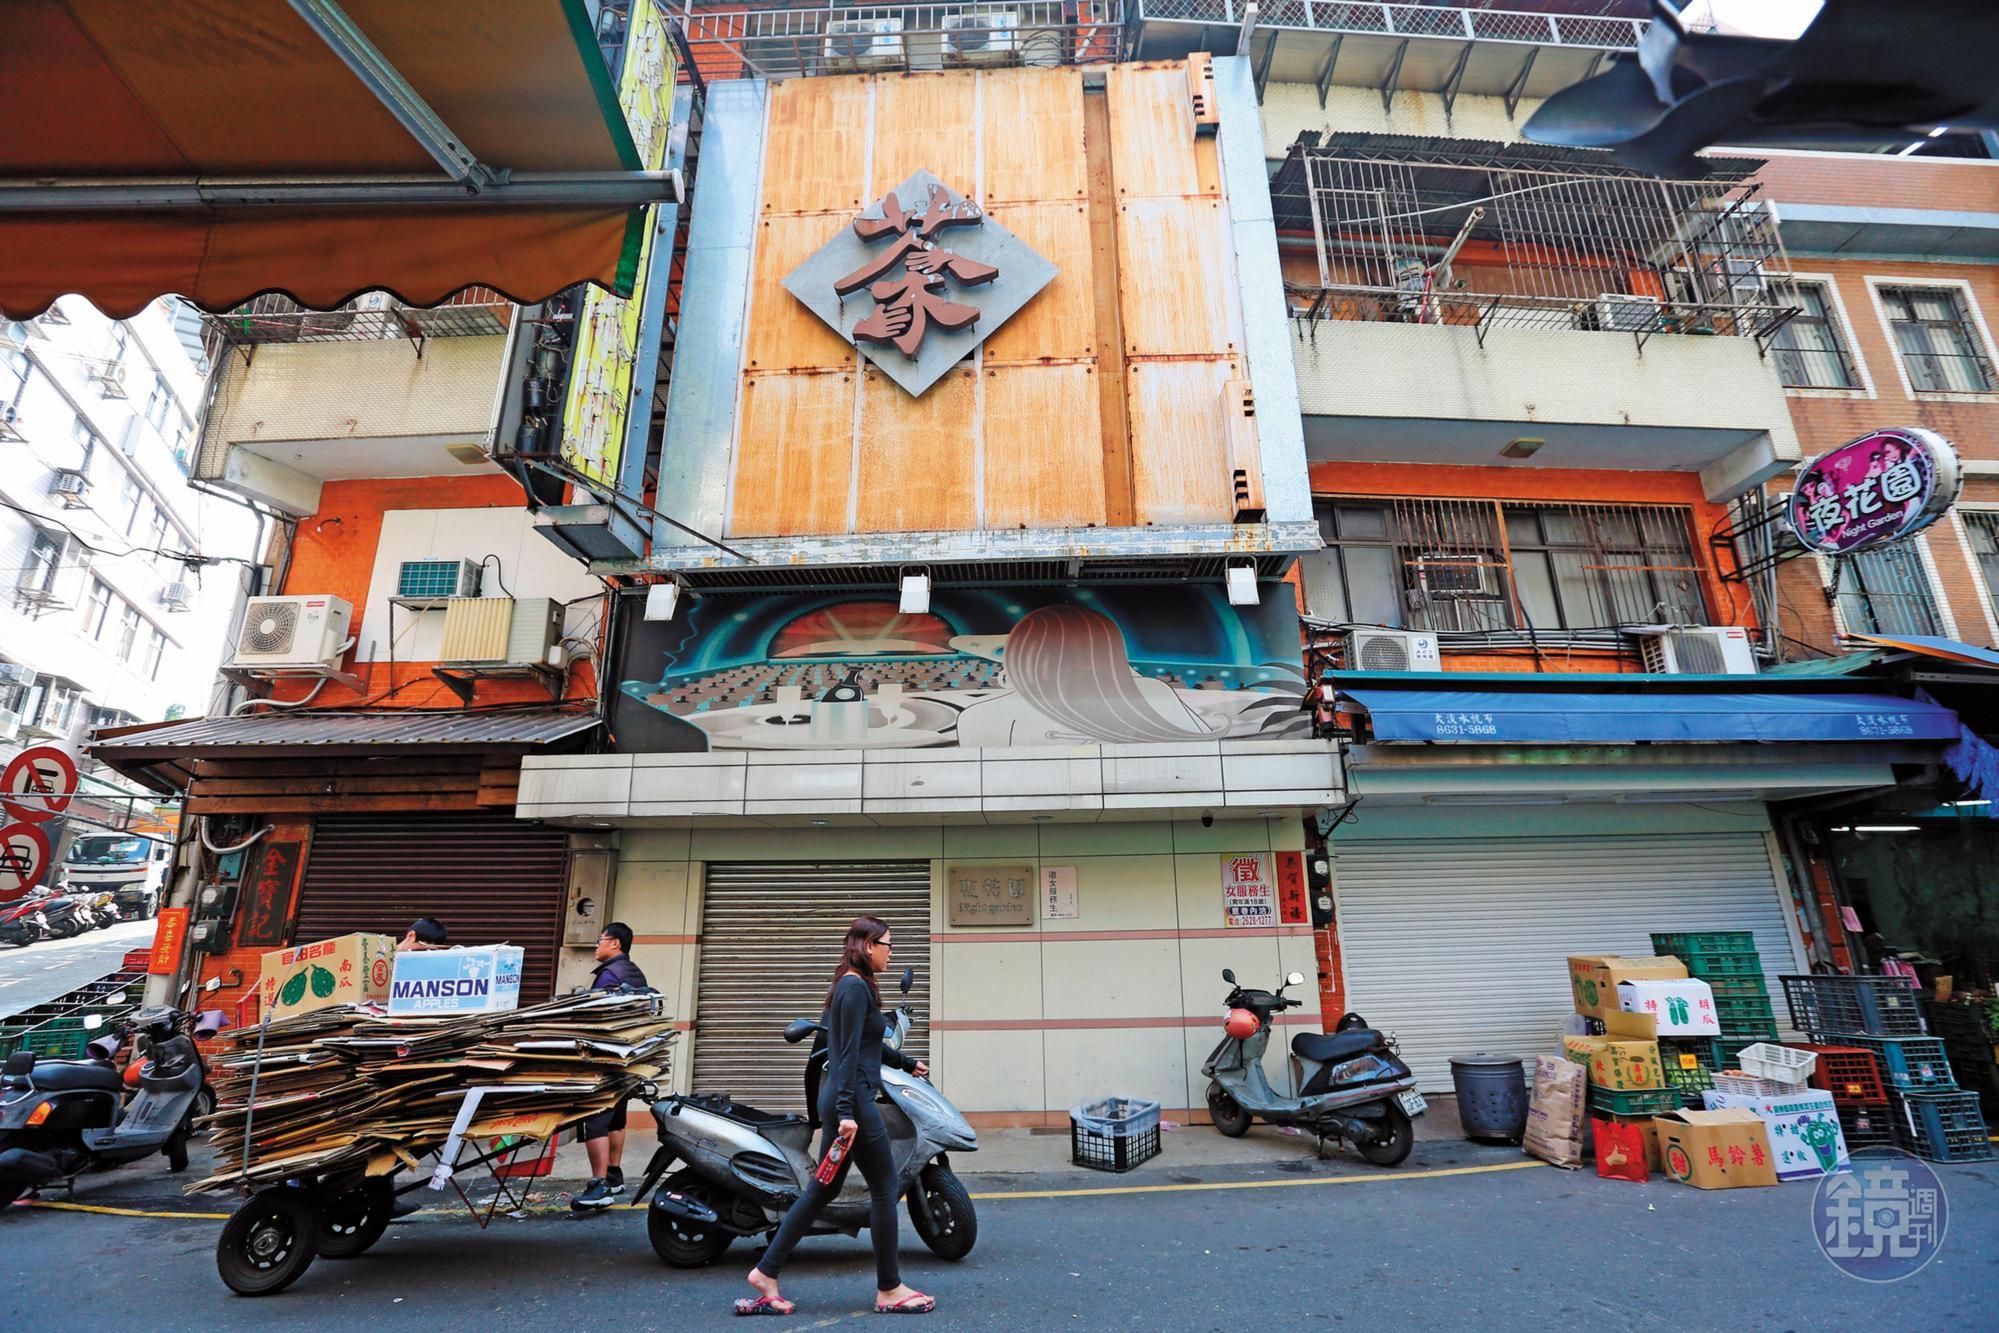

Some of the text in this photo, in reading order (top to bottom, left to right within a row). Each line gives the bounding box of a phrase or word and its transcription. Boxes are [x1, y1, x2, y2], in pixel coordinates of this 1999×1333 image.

[1809, 461, 1923, 531] 夜花園
[1842, 510, 1904, 539] Night Garden
[1436, 725, 1497, 735] 8631-5868
[1231, 856, 1261, 883] 徵
[1225, 884, 1270, 898] 女服務生
[339, 958, 353, 989] 南瓜
[495, 974, 520, 984] MANSON
[392, 978, 489, 998] MANSON
[413, 998, 459, 1009] APPLES
[1698, 998, 1716, 1025] 胡瓜
[1707, 1142, 1765, 1168] 馬鈴薯
